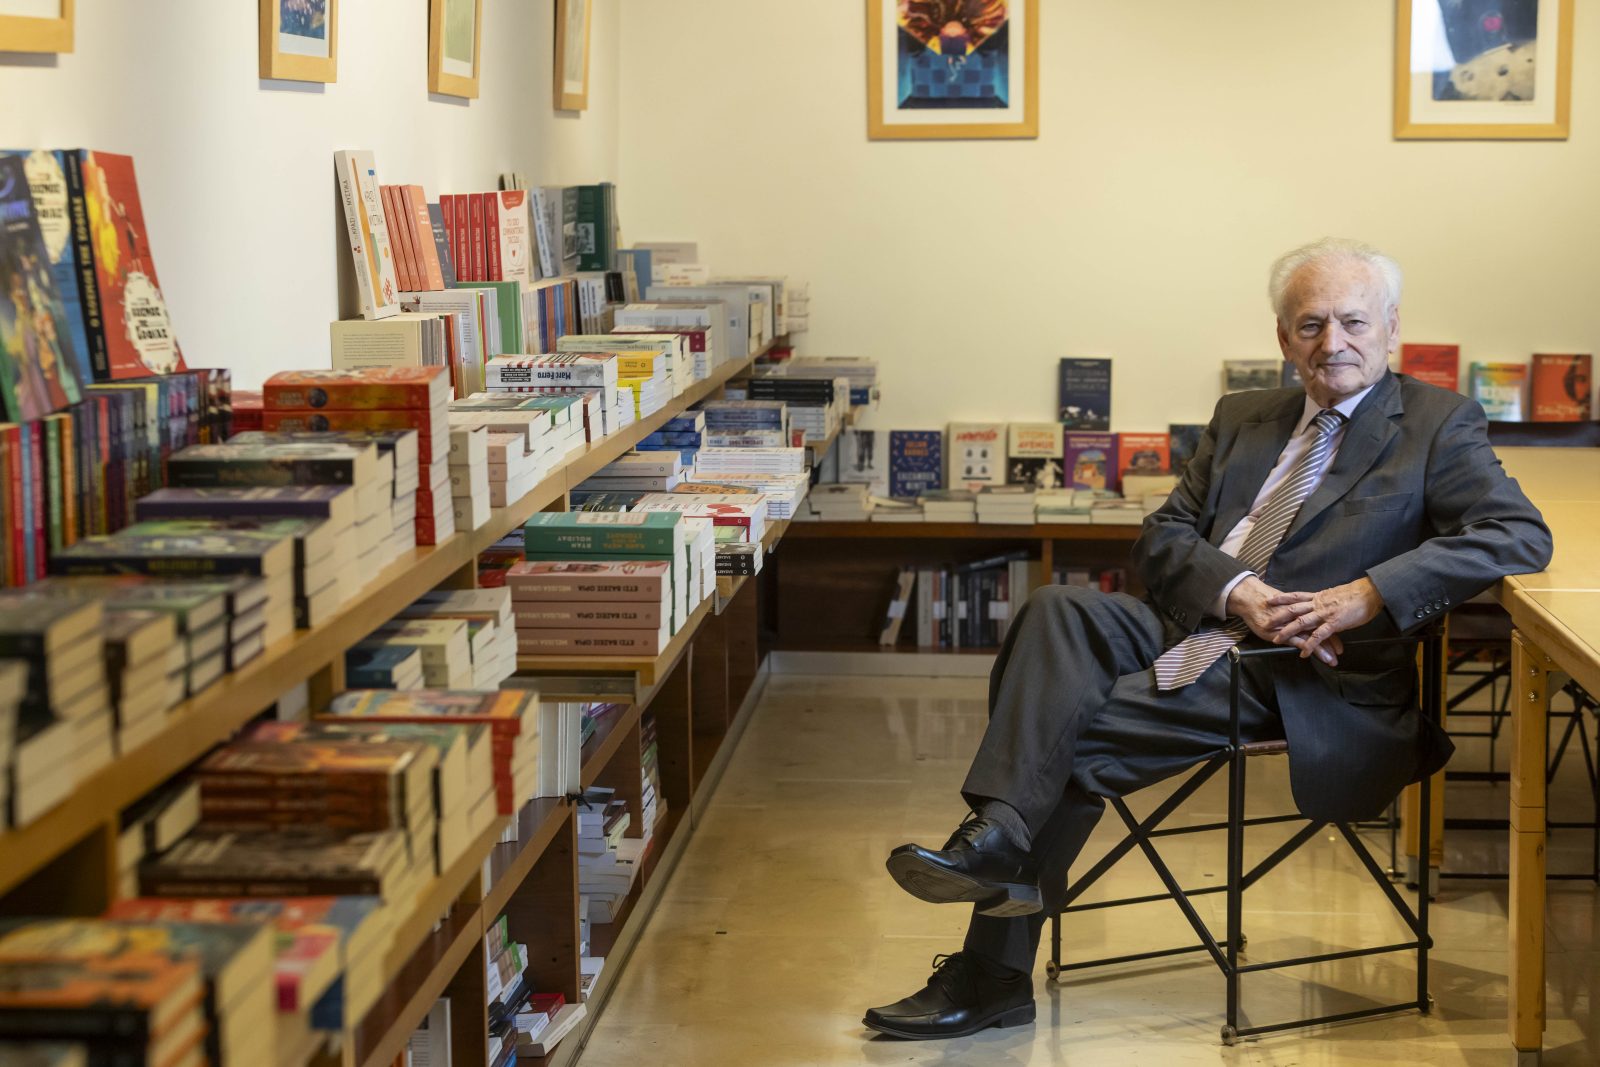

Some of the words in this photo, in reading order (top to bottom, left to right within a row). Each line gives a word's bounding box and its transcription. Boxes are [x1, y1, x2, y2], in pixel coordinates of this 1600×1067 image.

[537, 371, 555, 380] Ferro
[555, 371, 572, 380] Marc
[1017, 431, 1055, 440] UTOPIA
[1017, 440, 1055, 449] AVENUE
[557, 535, 592, 543] HOLIDAY
